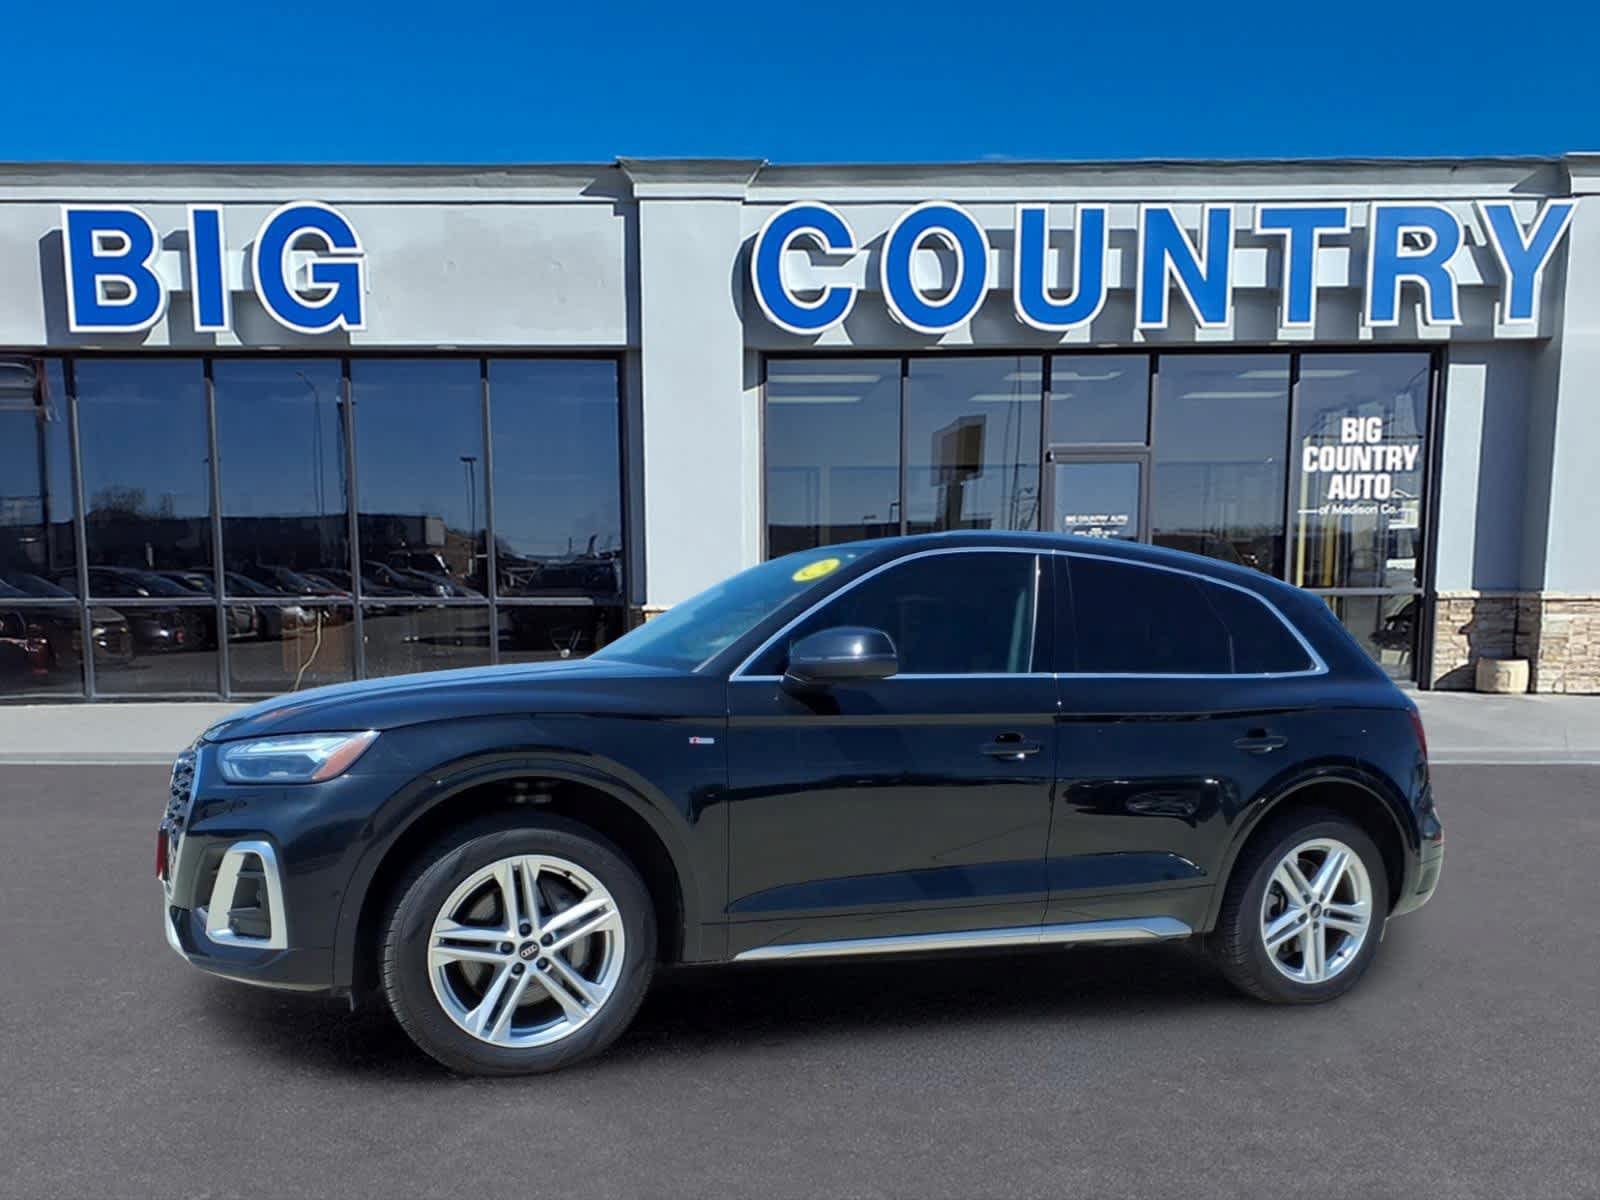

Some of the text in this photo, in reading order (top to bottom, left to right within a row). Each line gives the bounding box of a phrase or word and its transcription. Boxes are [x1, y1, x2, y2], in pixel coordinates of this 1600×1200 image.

[61, 200, 367, 334] BIG
[750, 199, 1577, 333] COUNTRY
[1341, 417, 1383, 444] BIG
[1302, 444, 1420, 472] COUNTRY
[1327, 473, 1392, 501] AUTO
[1319, 503, 1330, 515] of
[1332, 503, 1379, 515] Madison
